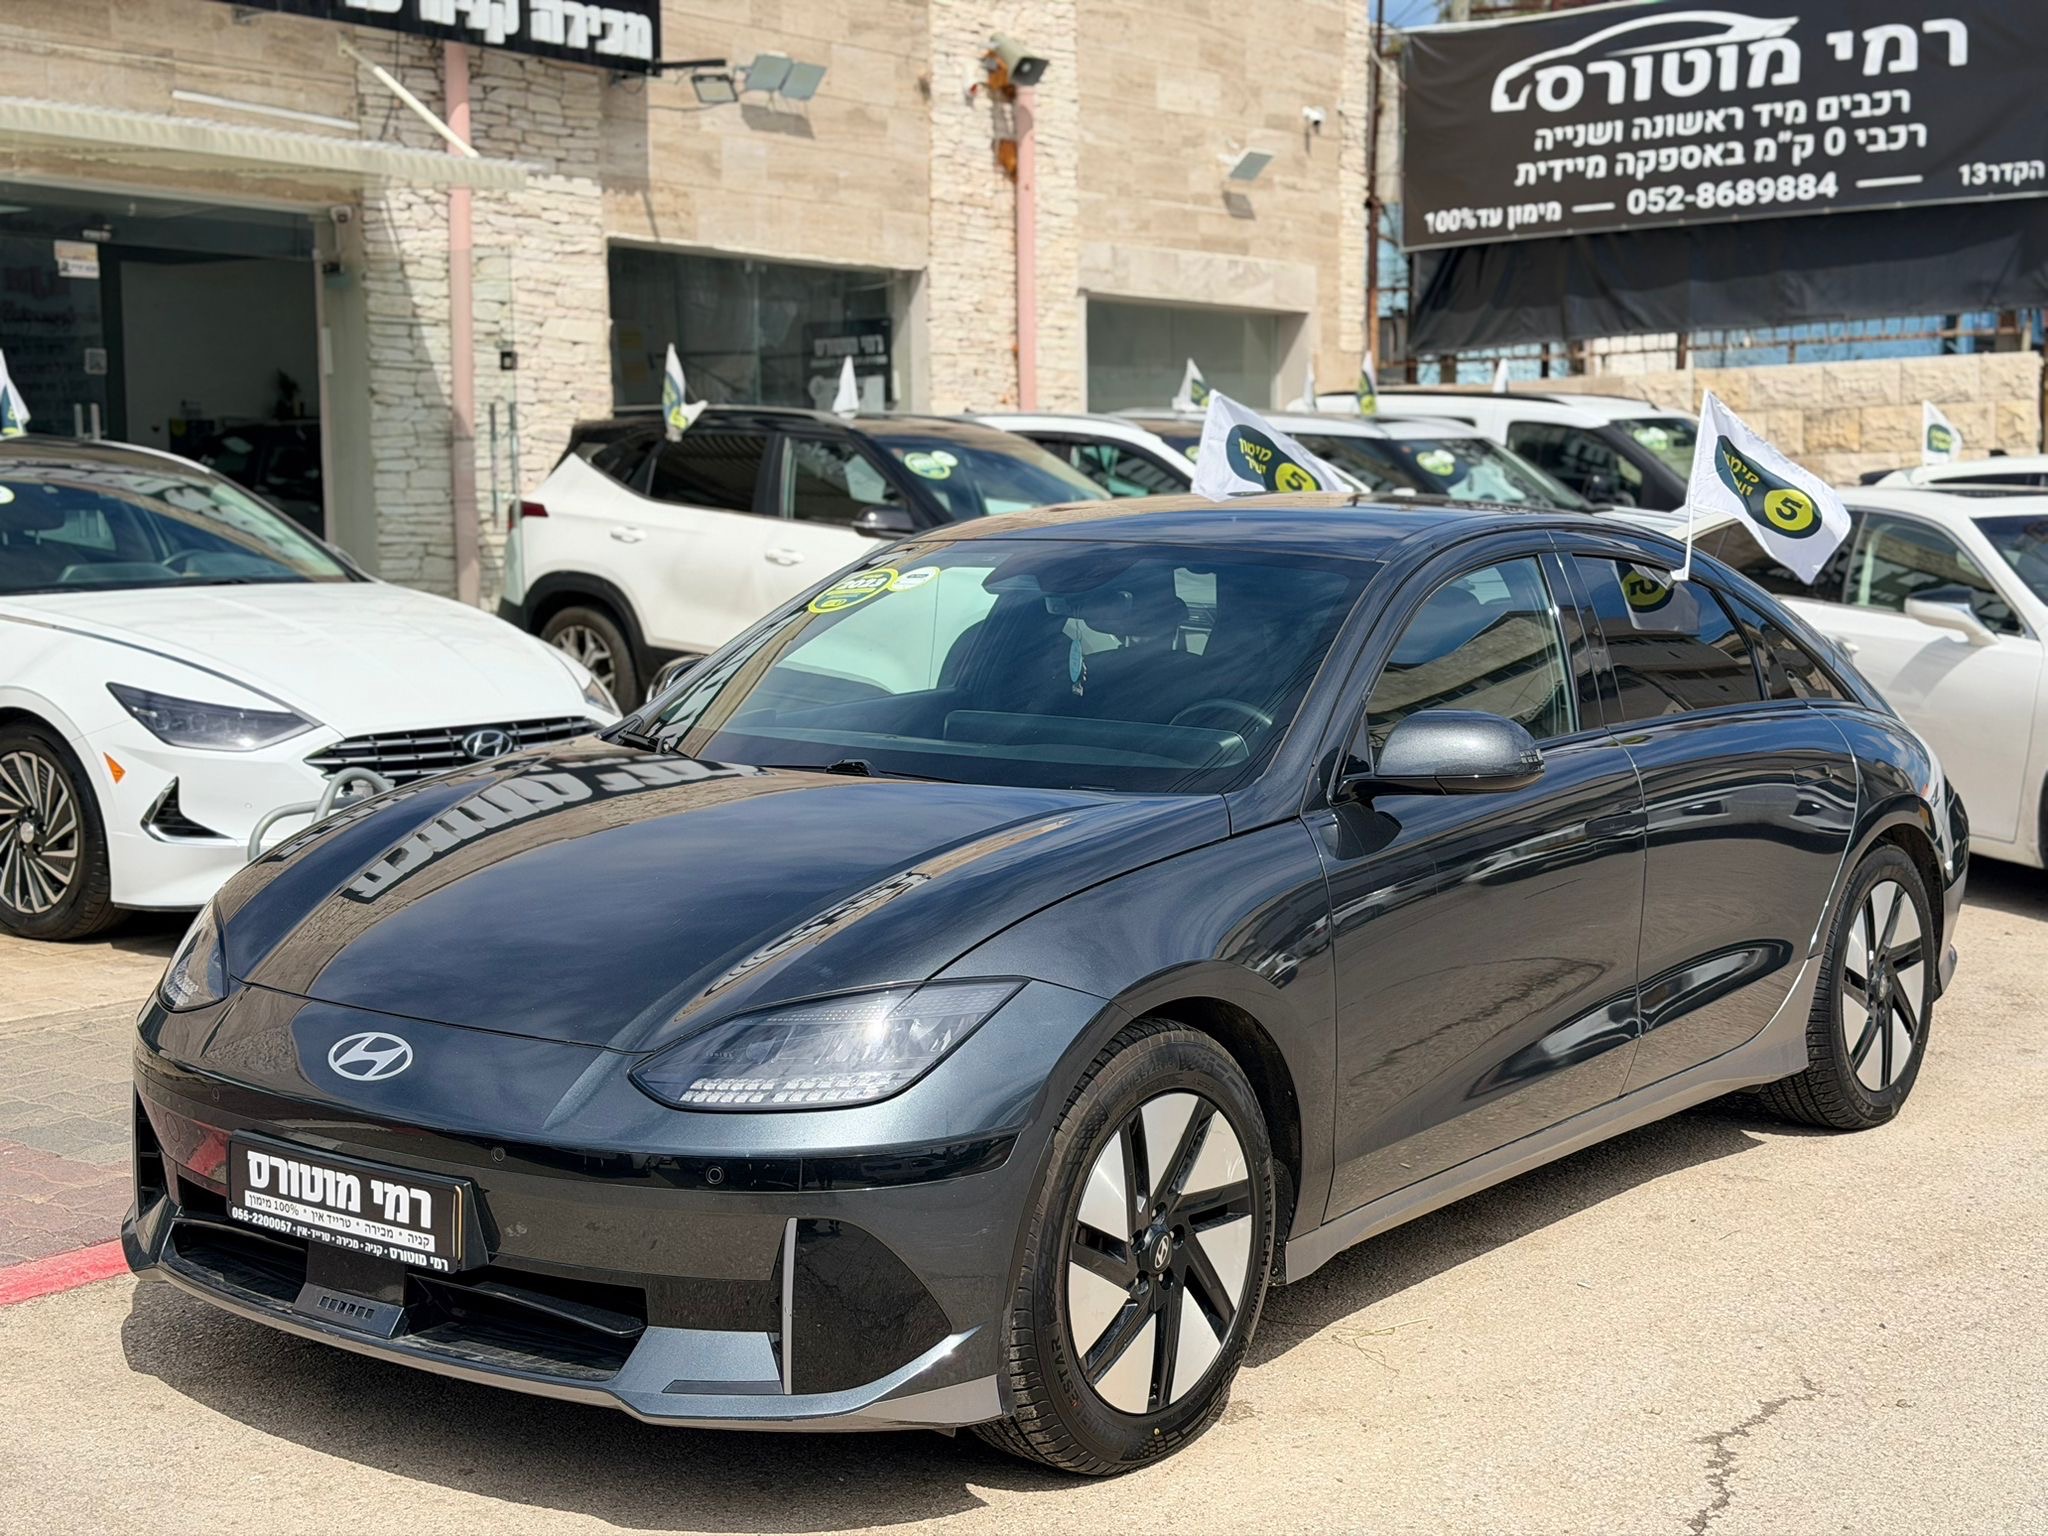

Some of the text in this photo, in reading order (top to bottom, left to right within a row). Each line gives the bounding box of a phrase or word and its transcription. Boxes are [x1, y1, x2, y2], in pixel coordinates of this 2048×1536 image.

[530, 1, 652, 60] מכירה
[1535, 18, 1968, 112] רמי מוטורס
[1534, 89, 1911, 151] רכבים מיד ראשונה ושנייה
[1824, 126, 1846, 156] 0
[1855, 123, 1927, 152] רכבי
[1514, 154, 1607, 186] מיידית
[1615, 140, 1745, 181] באספקה
[1627, 171, 1838, 214] 052-8689884
[1507, 201, 1562, 230] מימון
[1285, 471, 1308, 491] 5
[1775, 497, 1804, 521] 5
[247, 1150, 432, 1230] רמי מוטורס
[249, 1194, 272, 1208] מימון
[231, 1206, 293, 1233] 055-2200057
[274, 1201, 300, 1216] 100%
[336, 1235, 360, 1249] מכירה
[364, 1223, 395, 1240] מכירה
[408, 1232, 431, 1250] קניה
[364, 1242, 384, 1257] קניה
[389, 1247, 428, 1266] מוטורס
[430, 1256, 449, 1271] רמי
